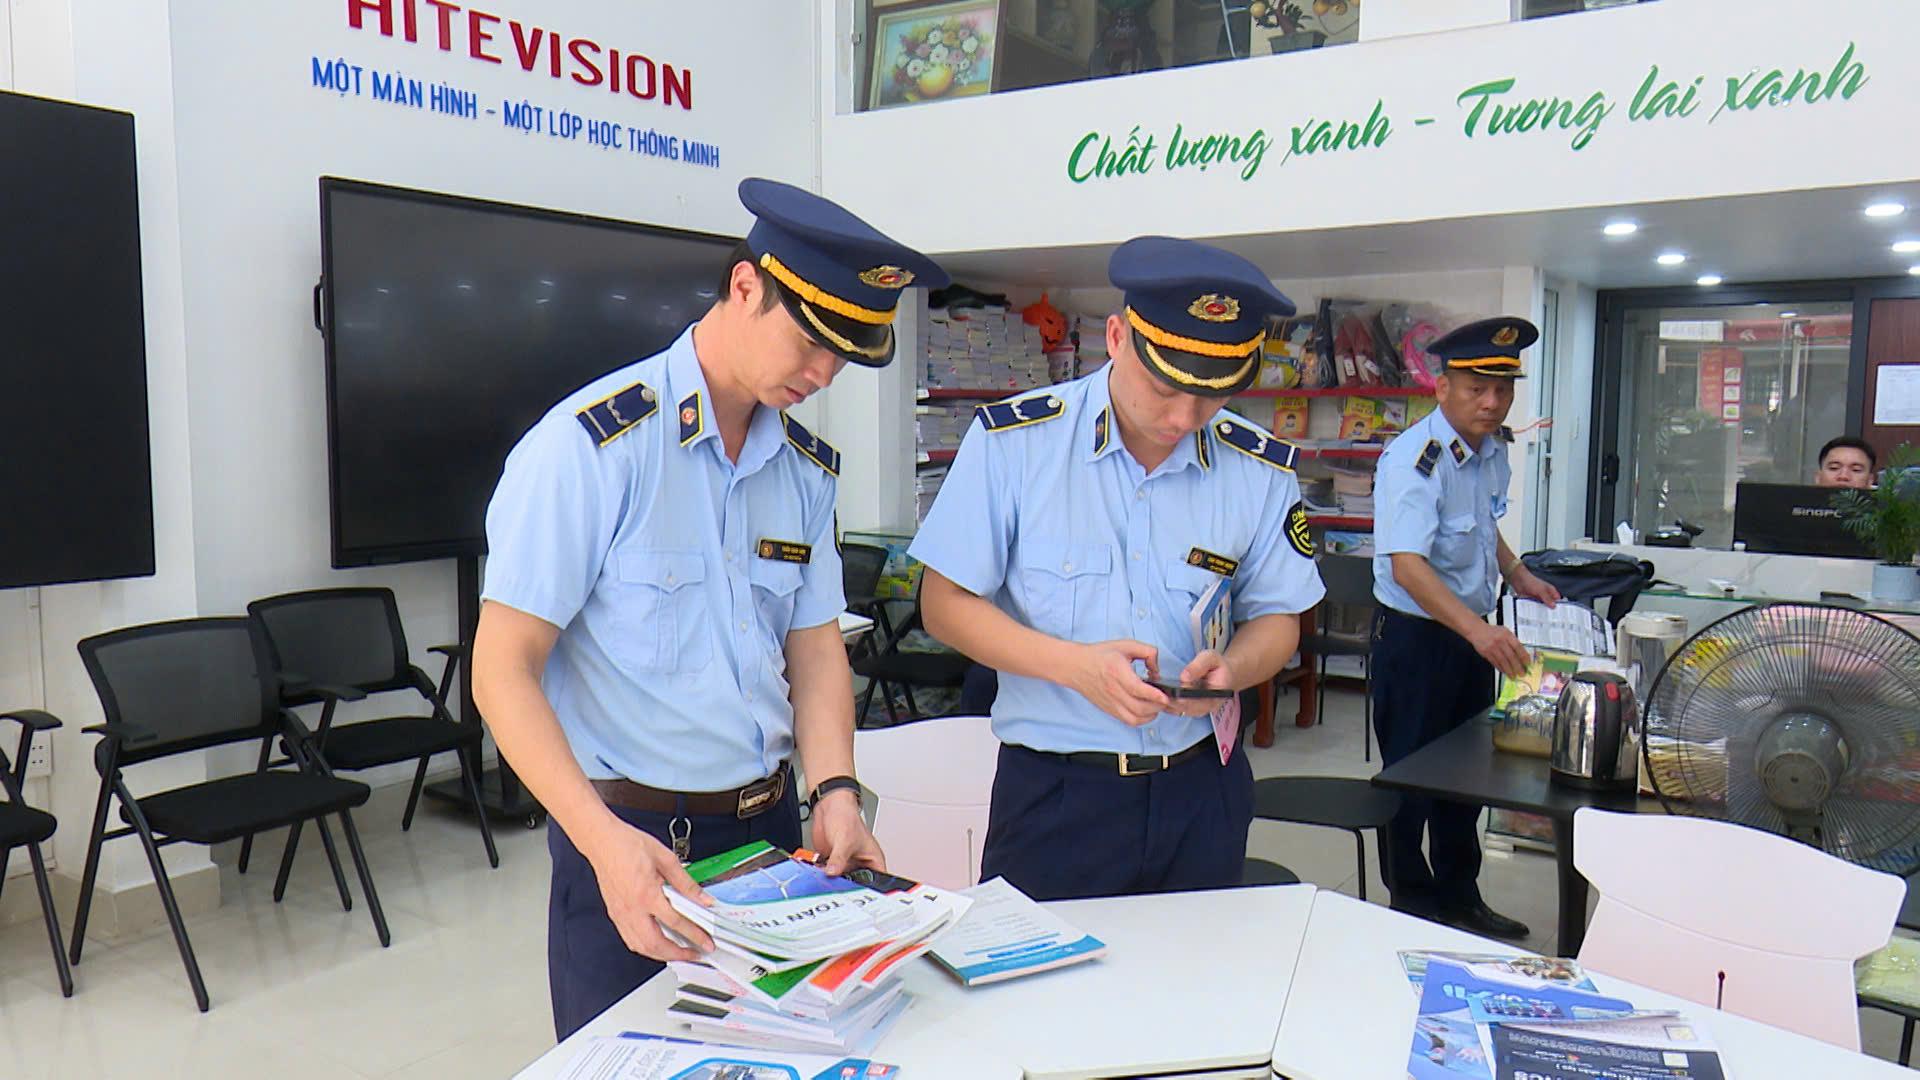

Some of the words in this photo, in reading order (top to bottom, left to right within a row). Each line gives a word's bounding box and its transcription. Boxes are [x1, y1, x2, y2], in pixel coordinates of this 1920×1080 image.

[348, 0, 693, 110] HITEVISION
[311, 56, 363, 97] MỘT
[372, 70, 423, 109] MÀN
[430, 81, 478, 120] HÌNH
[503, 99, 543, 135] MỘT
[549, 107, 584, 140] LỚP
[588, 119, 623, 150] HỌC
[628, 127, 680, 161] THÔNG
[682, 139, 721, 169] MINH
[1067, 125, 1158, 184] Chất
[1165, 123, 1273, 182] lượng
[1280, 98, 1393, 167] xanh
[1456, 77, 1615, 152] Tương
[1628, 64, 1704, 121] lai
[1708, 41, 1871, 125] xanh
